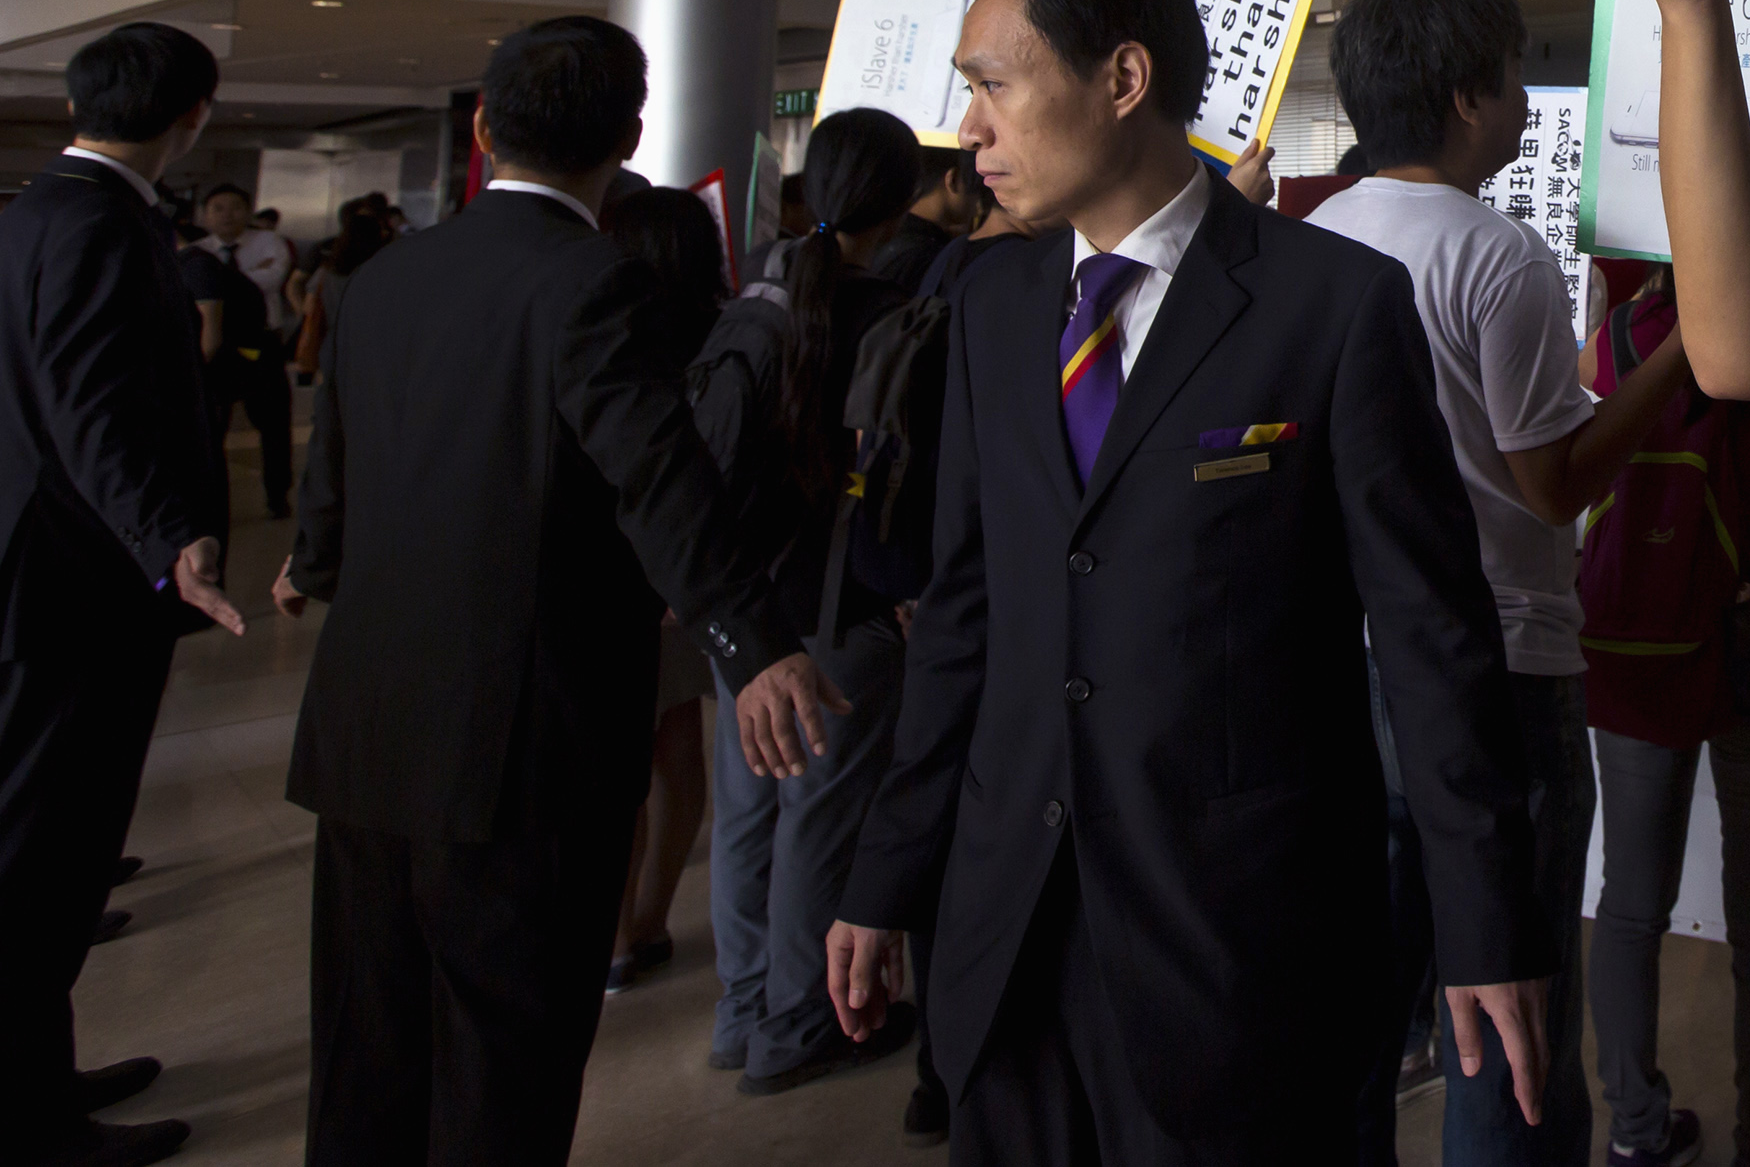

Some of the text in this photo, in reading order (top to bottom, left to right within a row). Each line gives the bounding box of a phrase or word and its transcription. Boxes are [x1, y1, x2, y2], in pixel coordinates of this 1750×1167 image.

[861, 18, 894, 89] iSlave 6
[1631, 153, 1651, 172] Still
